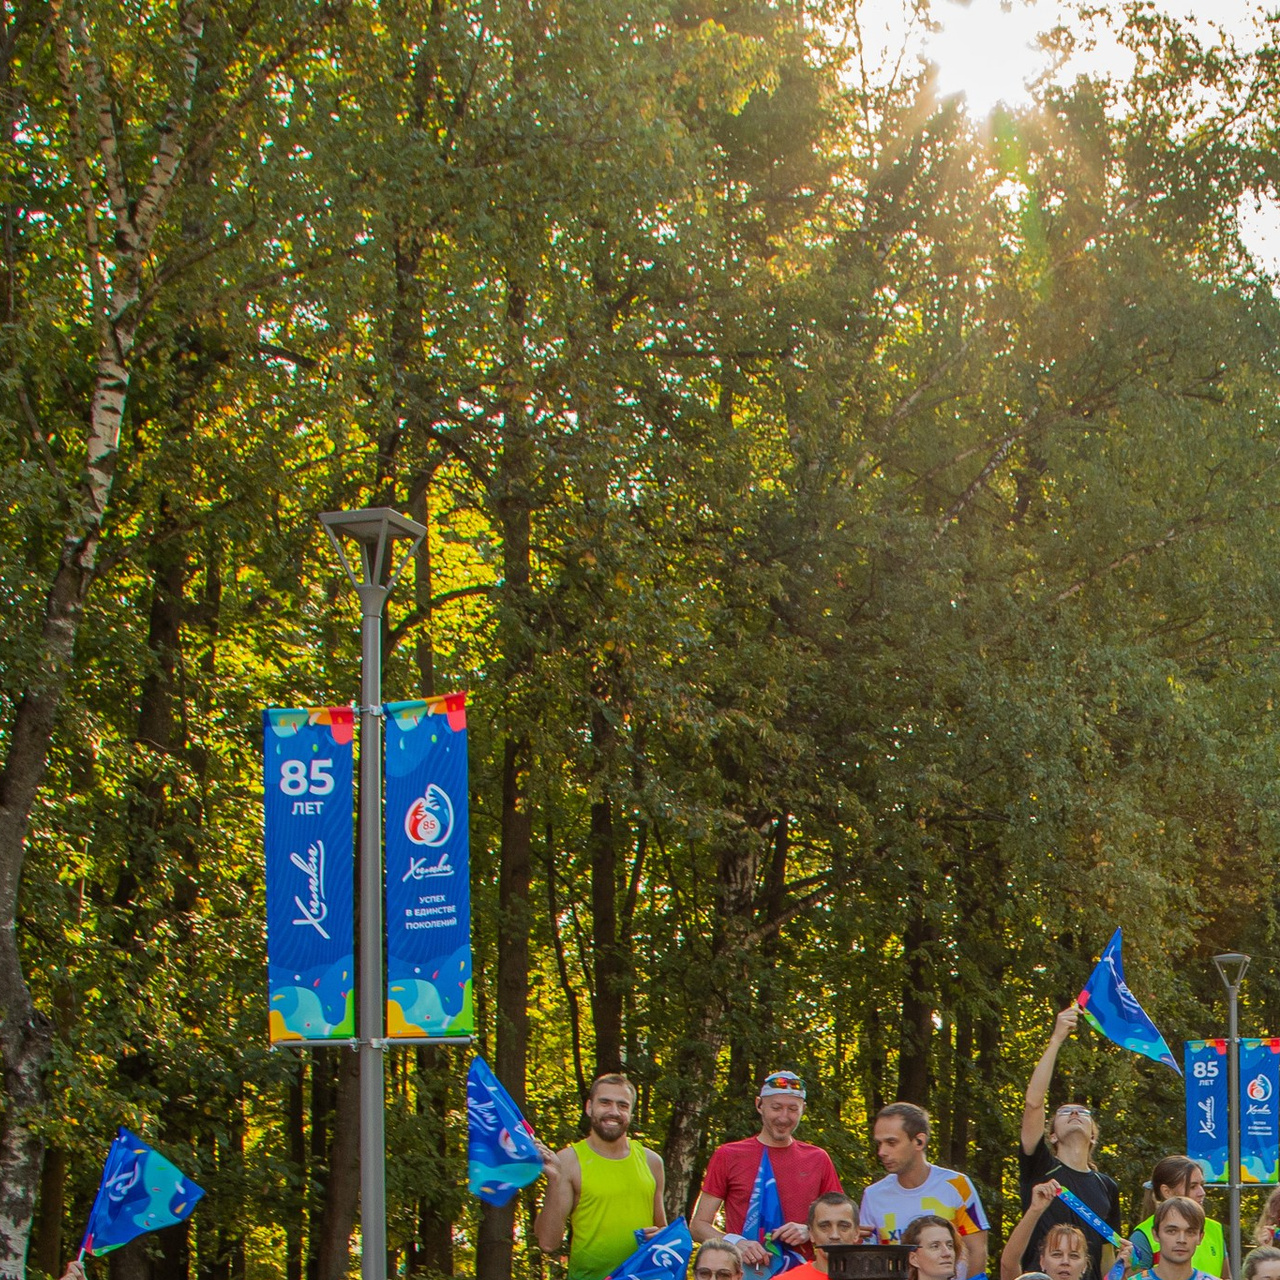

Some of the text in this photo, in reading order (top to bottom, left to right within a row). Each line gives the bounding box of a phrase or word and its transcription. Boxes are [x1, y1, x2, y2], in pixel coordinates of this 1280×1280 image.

[280, 758, 335, 795] 85
[292, 802, 324, 815] ЛЕТ
[422, 820, 436, 830] 85
[419, 895, 446, 904] УСПЕХ
[405, 905, 457, 917] В ЕДИНСТВЕ
[405, 917, 458, 930] ПОКОЛЕНИЙ
[1193, 1061, 1219, 1078] 85
